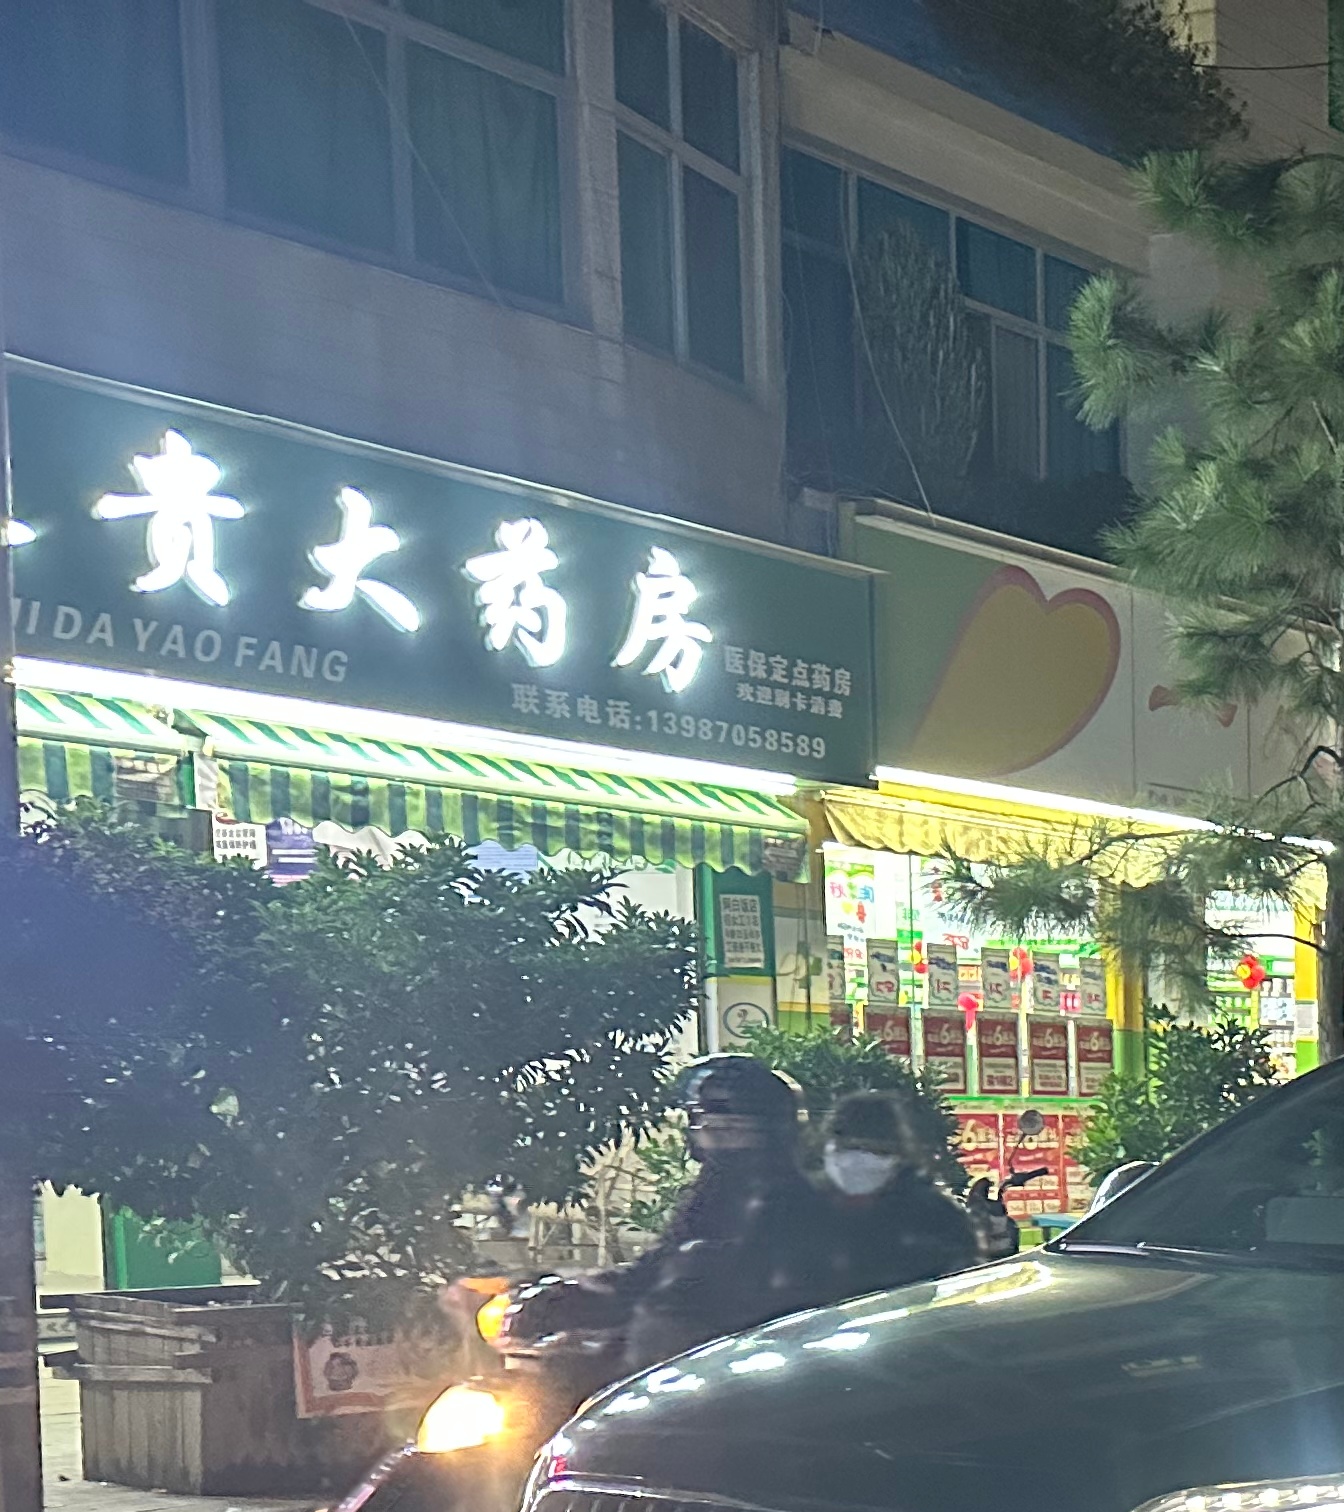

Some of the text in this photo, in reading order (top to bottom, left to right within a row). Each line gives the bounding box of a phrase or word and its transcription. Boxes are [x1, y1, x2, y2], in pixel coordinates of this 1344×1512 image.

[8, 427, 714, 692] 贵大药房
[53, 604, 115, 648] DA
[132, 618, 222, 663] YAO
[234, 636, 349, 683] FANG
[723, 645, 852, 697] 医保定点药房
[737, 682, 844, 719] 欢迎刷卡消费
